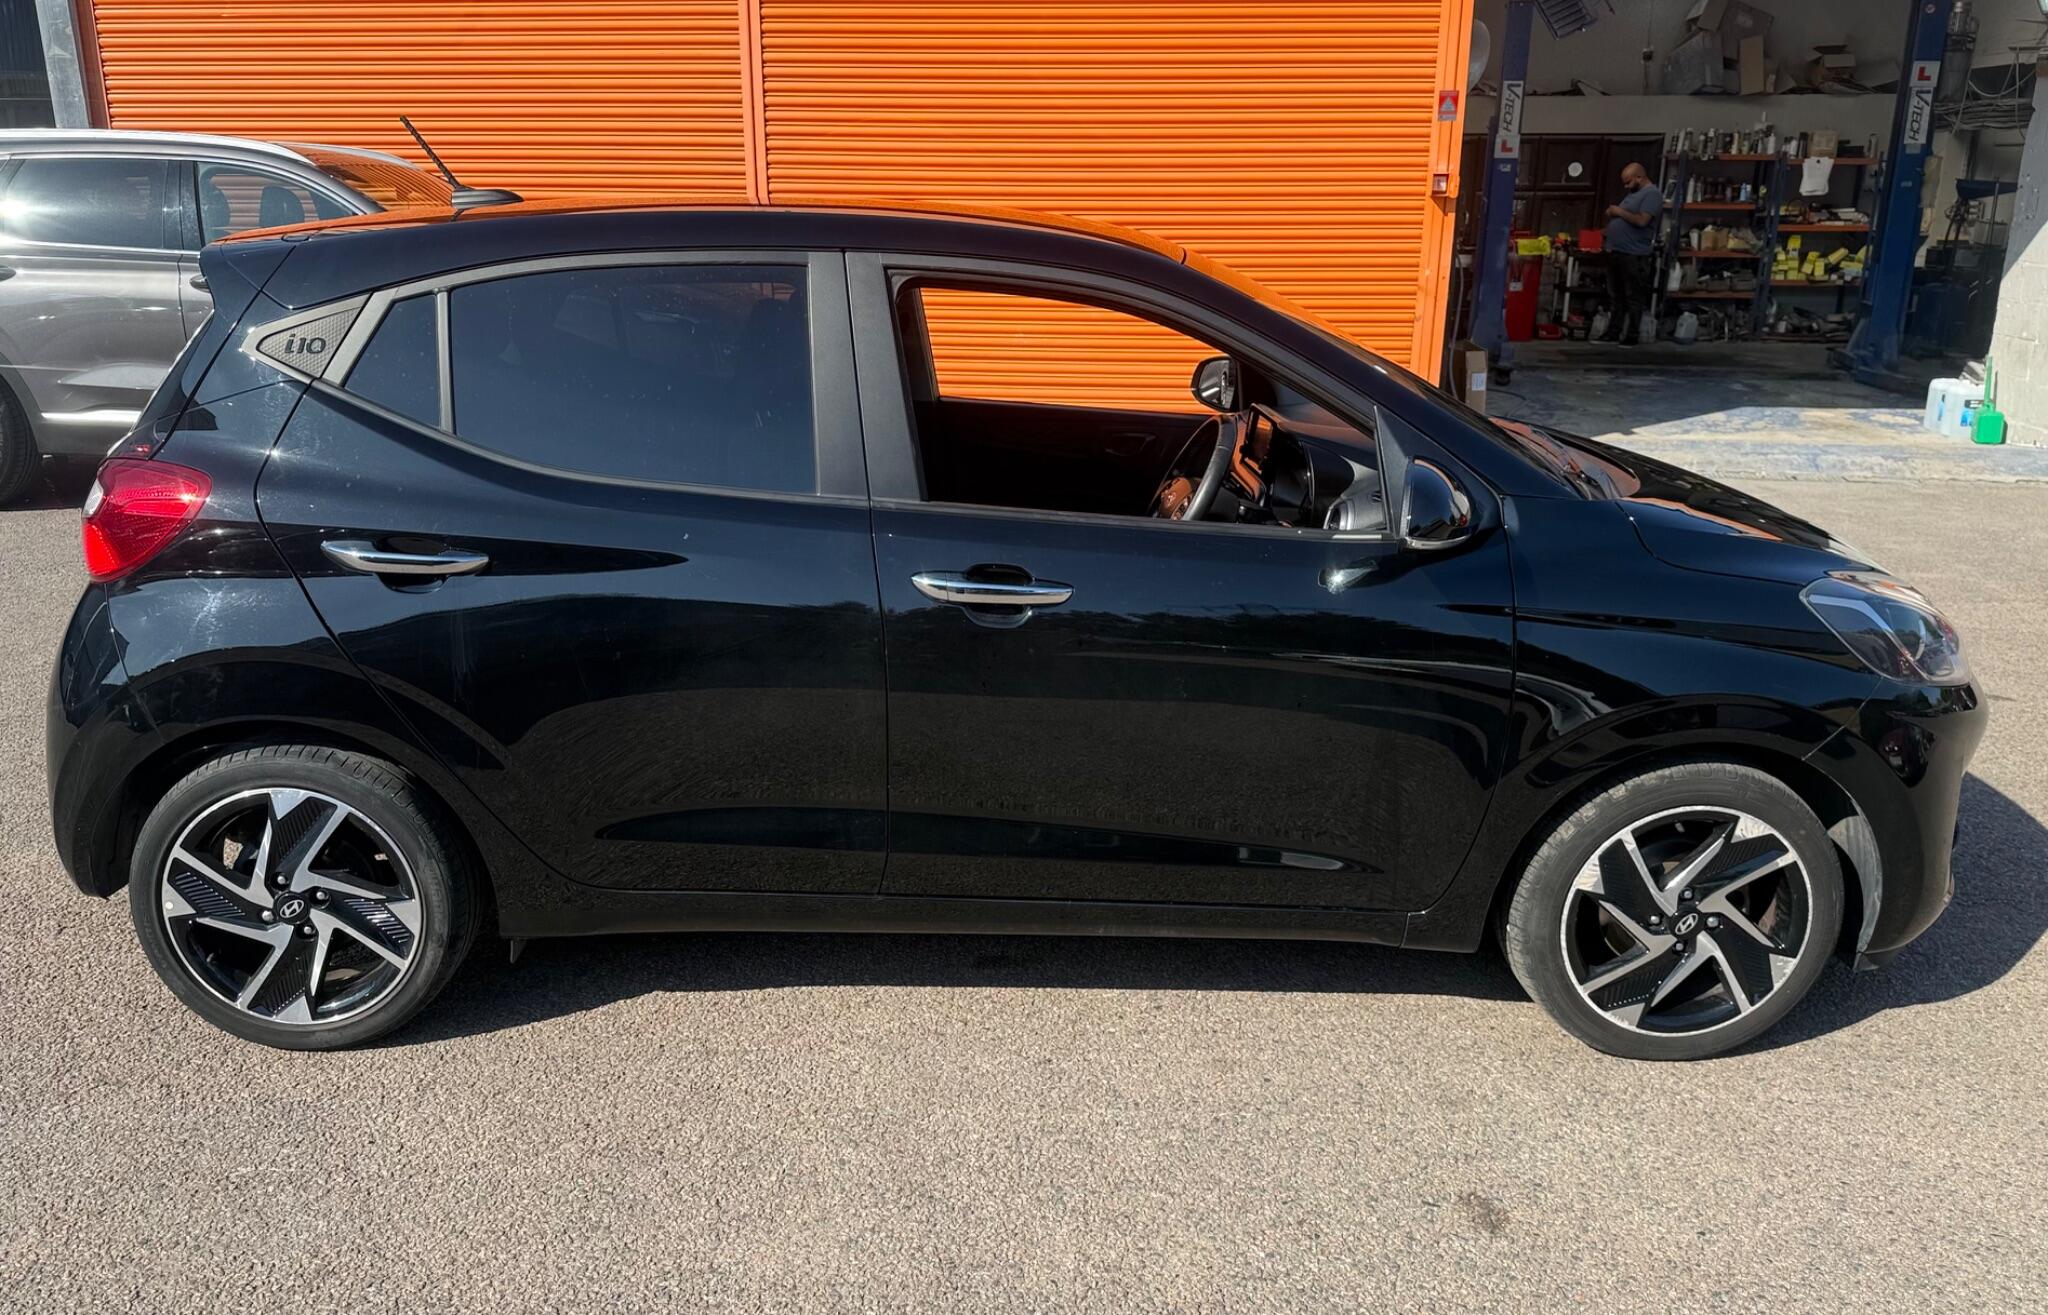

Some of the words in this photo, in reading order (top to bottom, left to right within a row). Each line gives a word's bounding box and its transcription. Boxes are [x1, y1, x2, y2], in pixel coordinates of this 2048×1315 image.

[1917, 66, 1932, 81] L
[1503, 83, 1521, 132] V-TECH
[1909, 89, 1932, 140] V-TECH
[1501, 139, 1513, 153] L
[284, 333, 326, 354] i10
